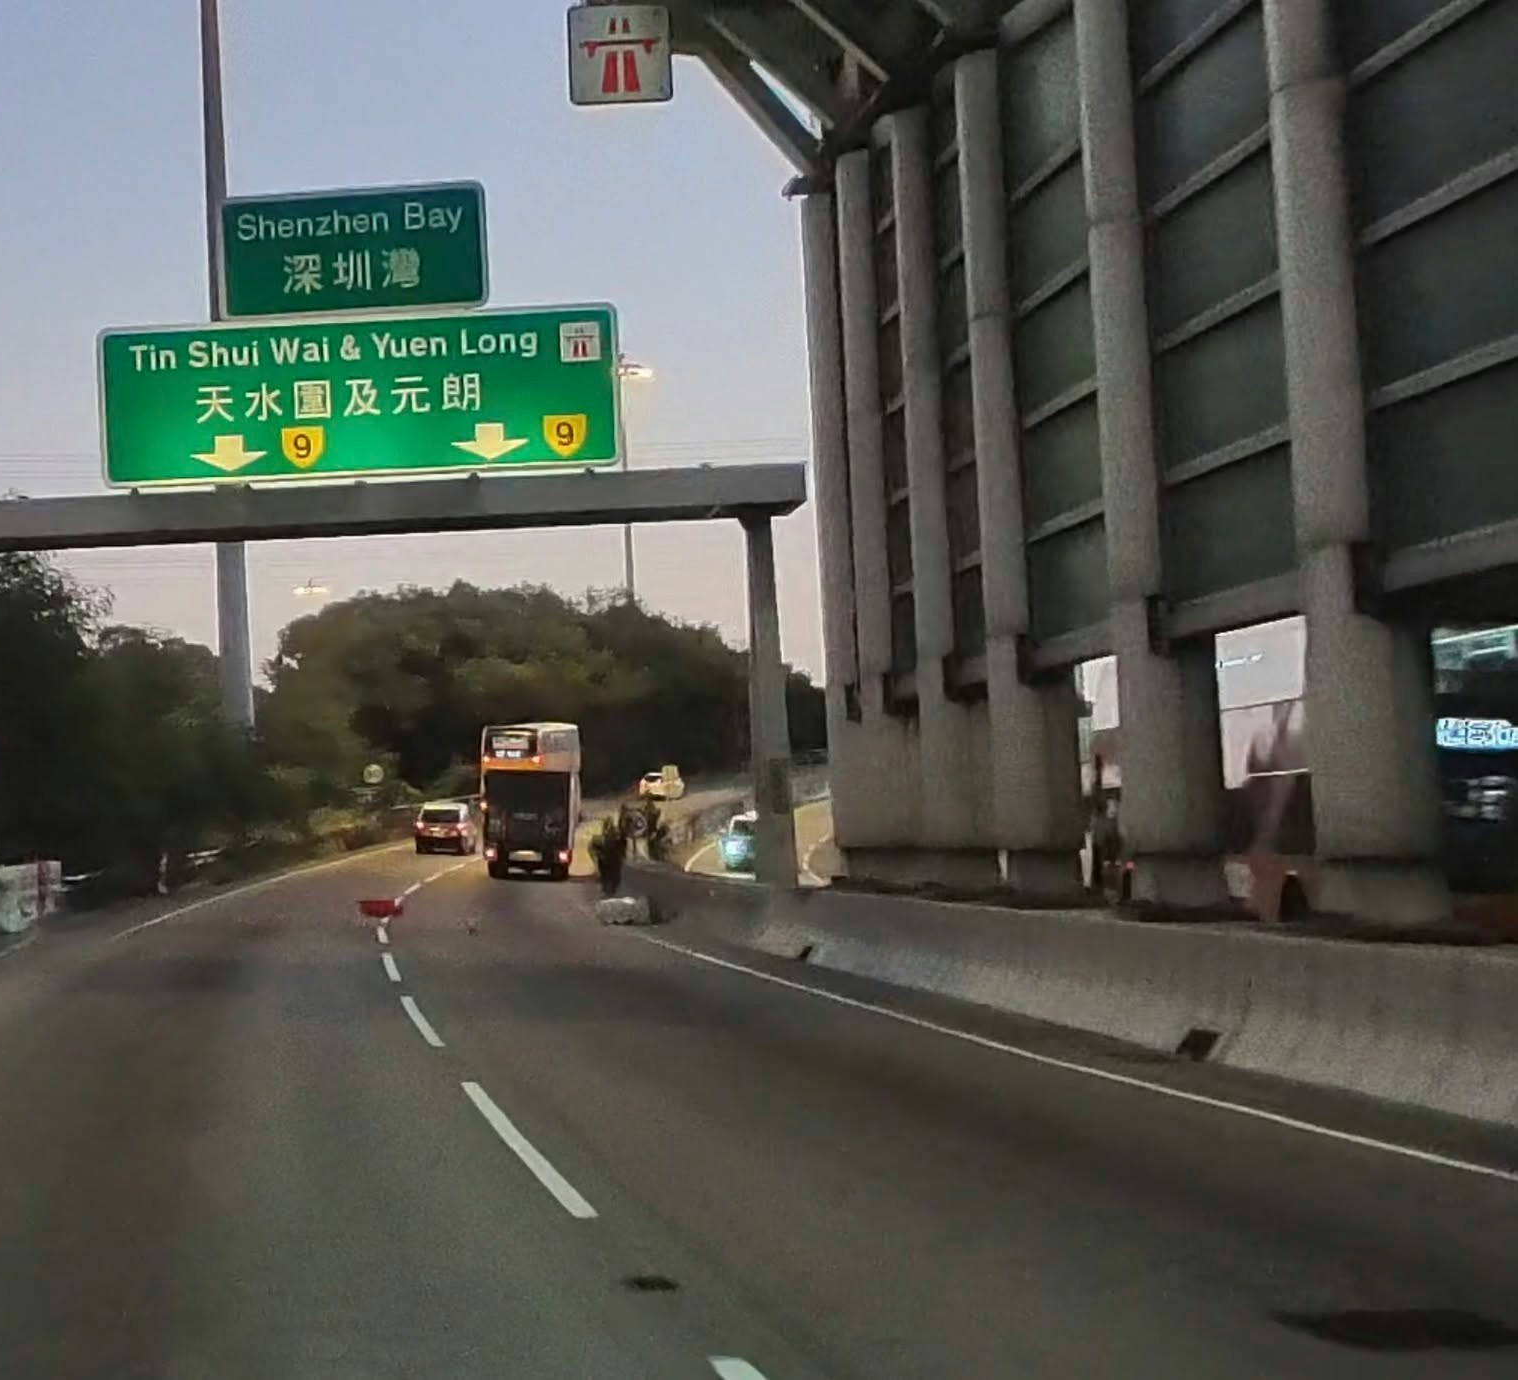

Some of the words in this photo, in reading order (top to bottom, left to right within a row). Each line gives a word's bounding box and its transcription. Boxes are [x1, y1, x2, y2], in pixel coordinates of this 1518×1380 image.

[237, 208, 390, 241] Shenzhen
[404, 203, 463, 235] Bay
[283, 249, 421, 295] 深圳灣
[129, 343, 177, 371] Tin
[188, 340, 260, 368] Shui
[271, 337, 330, 363] Wai
[340, 334, 362, 361] &
[371, 331, 448, 359] Yuen
[460, 328, 538, 357] Long
[196, 373, 482, 424] 天水圍及元朗
[293, 434, 313, 458] 9
[556, 421, 574, 446] 9
